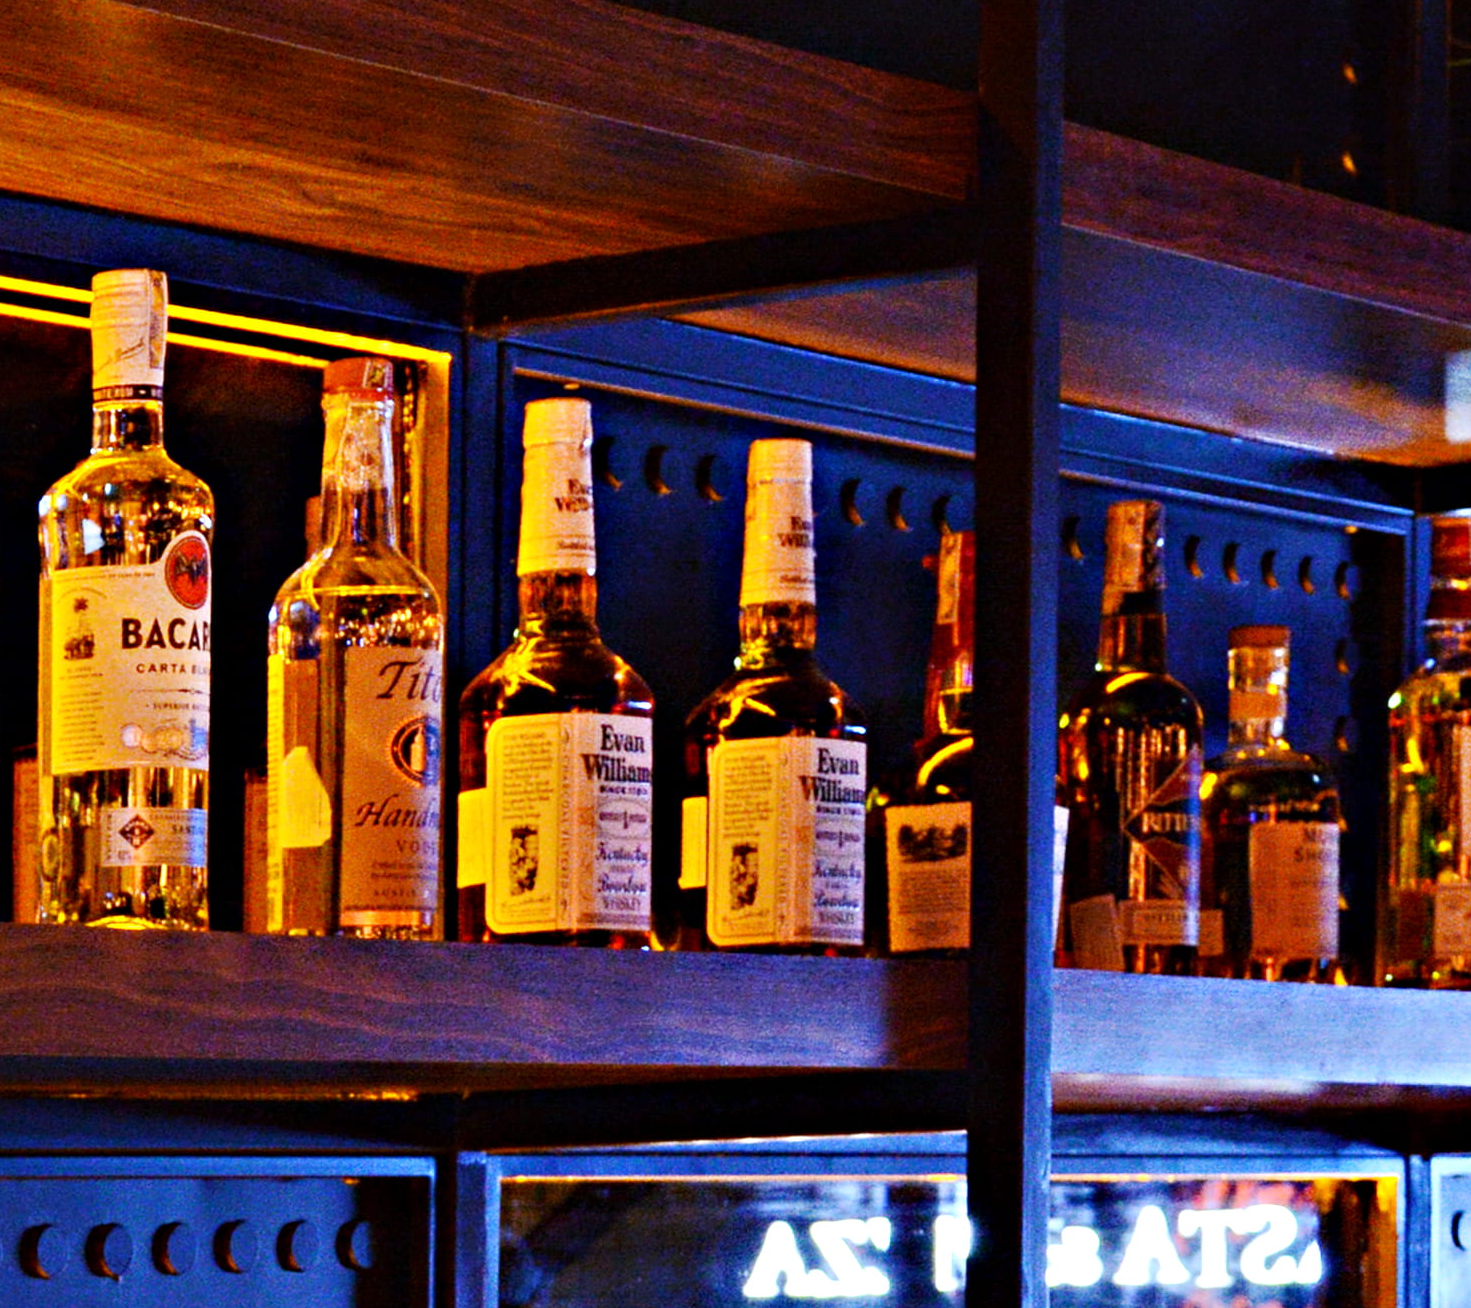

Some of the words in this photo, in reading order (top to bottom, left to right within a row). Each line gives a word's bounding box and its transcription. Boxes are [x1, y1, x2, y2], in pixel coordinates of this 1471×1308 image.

[135, 662, 187, 674] CARTA
[600, 723, 646, 753] Evan
[817, 746, 860, 775] Evan
